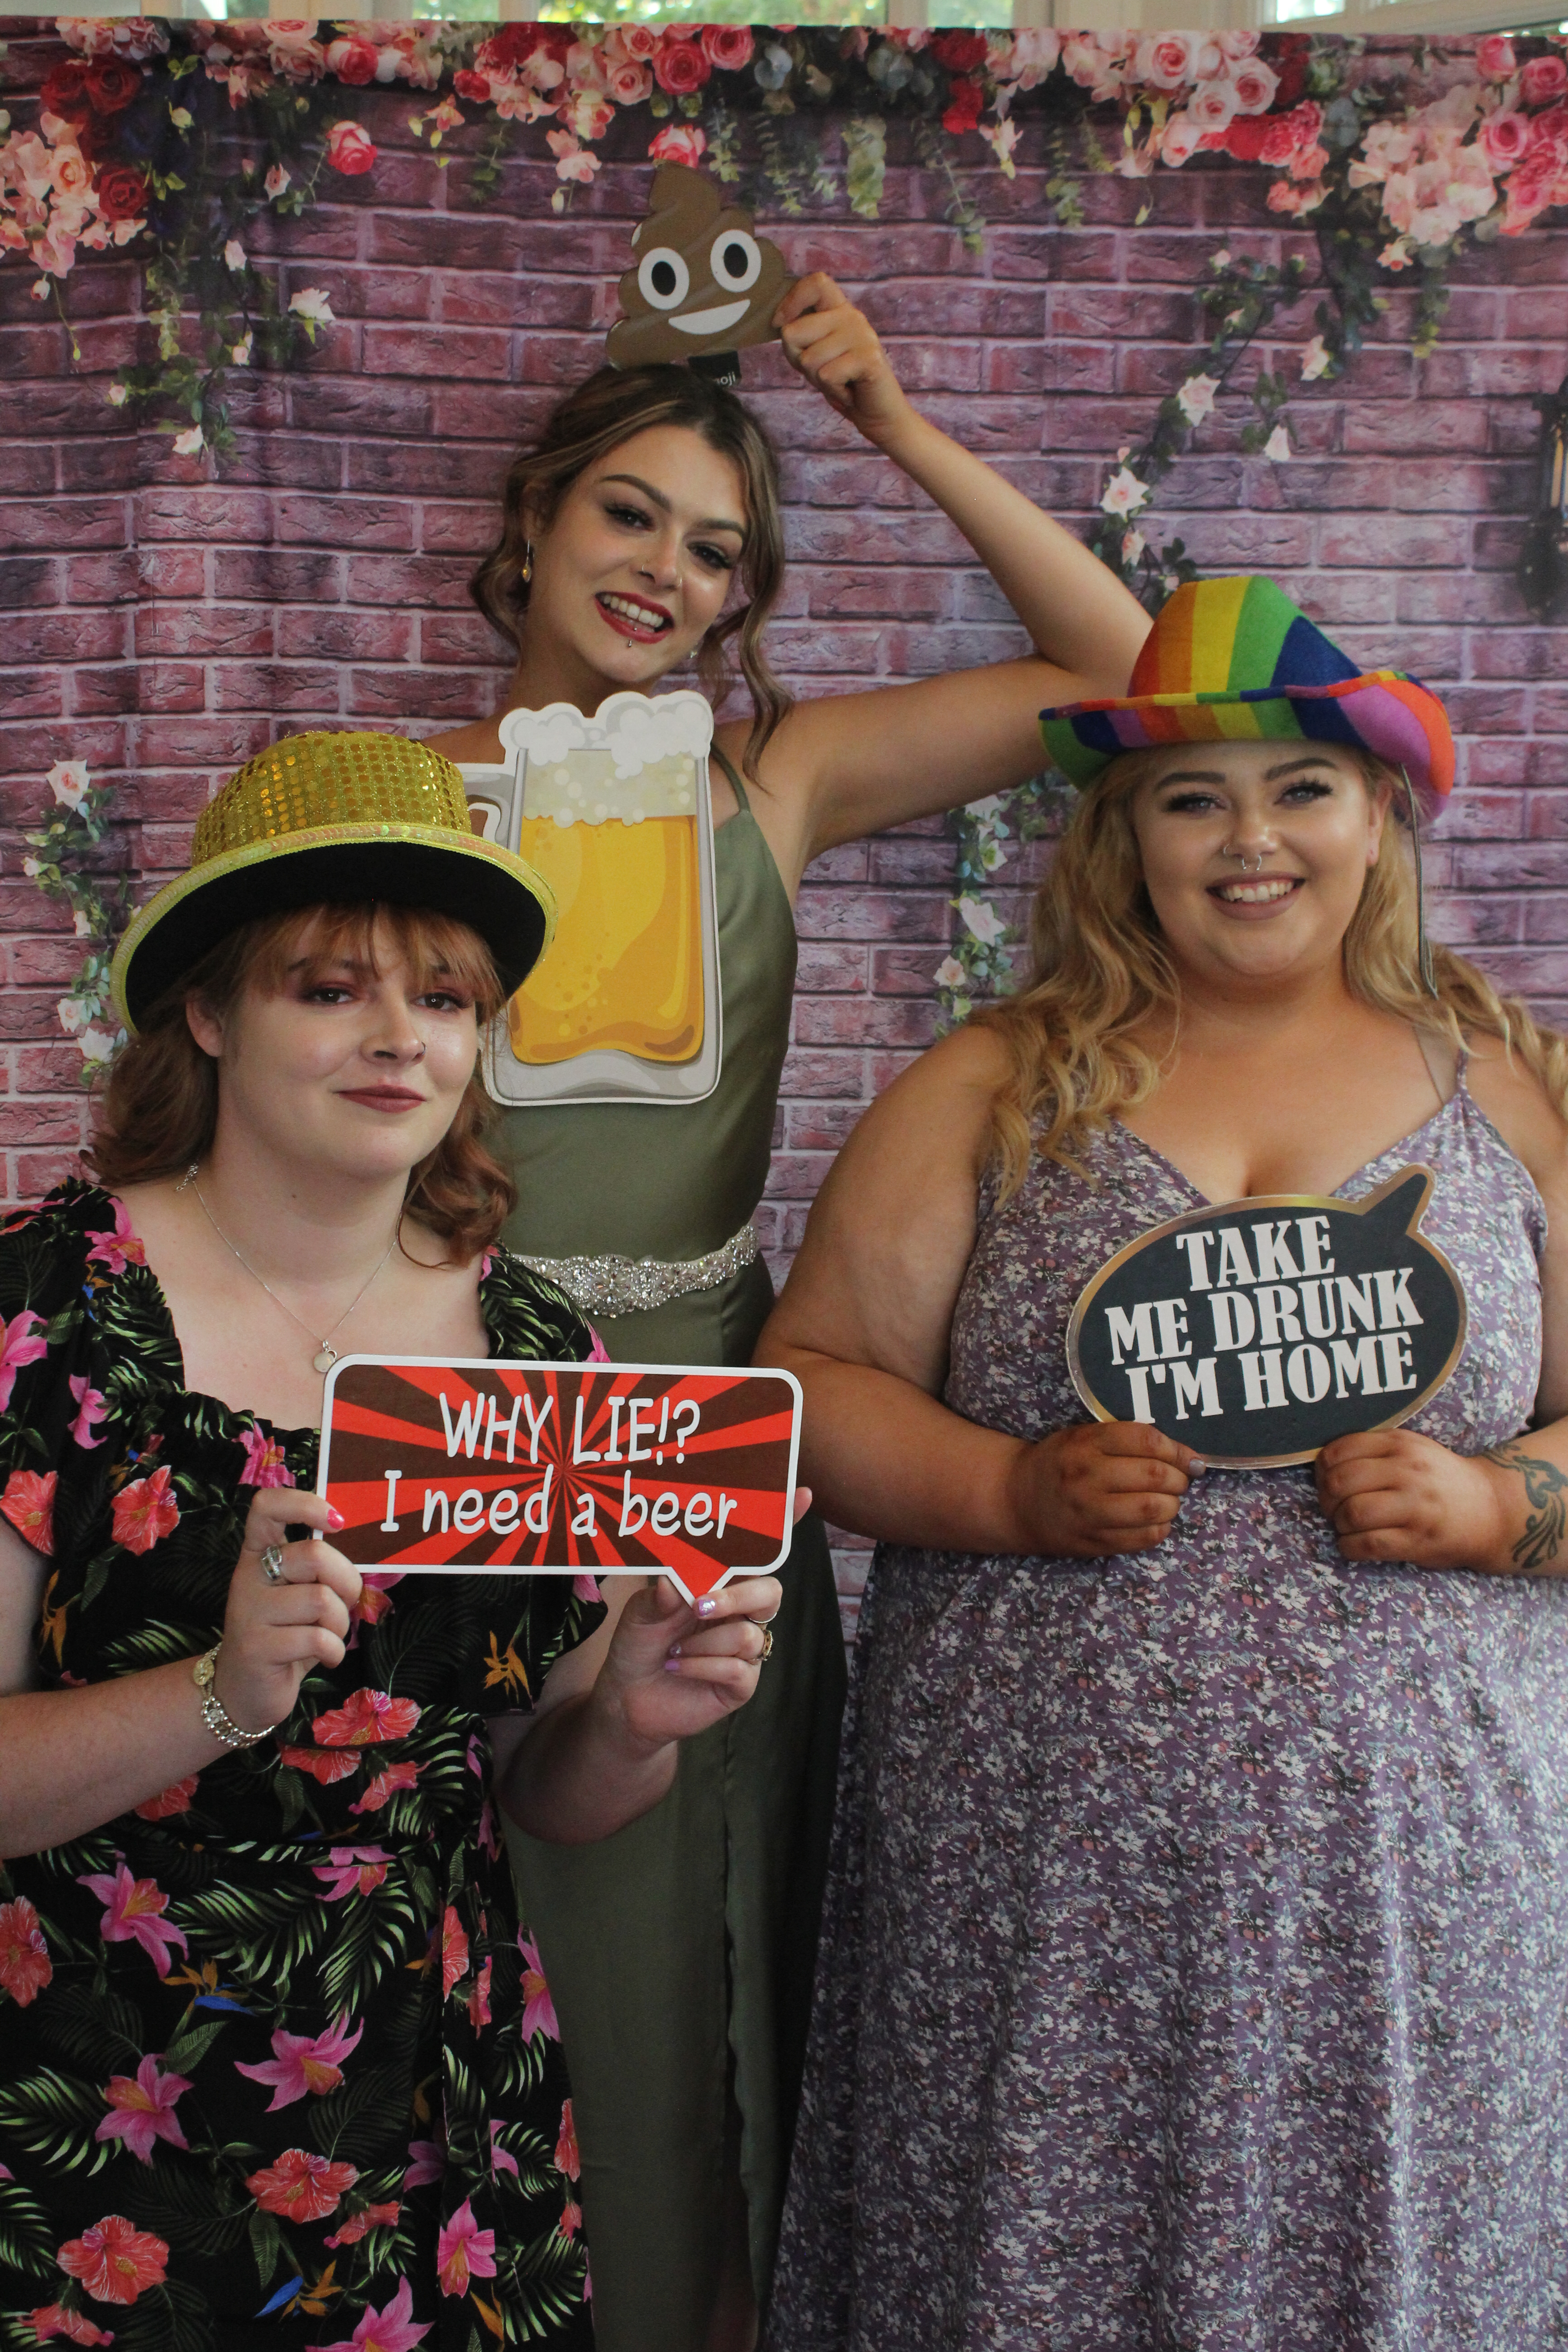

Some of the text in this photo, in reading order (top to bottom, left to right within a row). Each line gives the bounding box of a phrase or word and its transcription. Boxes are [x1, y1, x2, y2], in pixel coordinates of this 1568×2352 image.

[1176, 1215, 1335, 1292] TAKE
[1104, 1267, 1424, 1365] ME DRUNK
[1125, 1331, 1417, 1424] I'M HOME
[439, 1392, 701, 1466] WHY LIE!?
[380, 1463, 738, 1539] I need a beer
